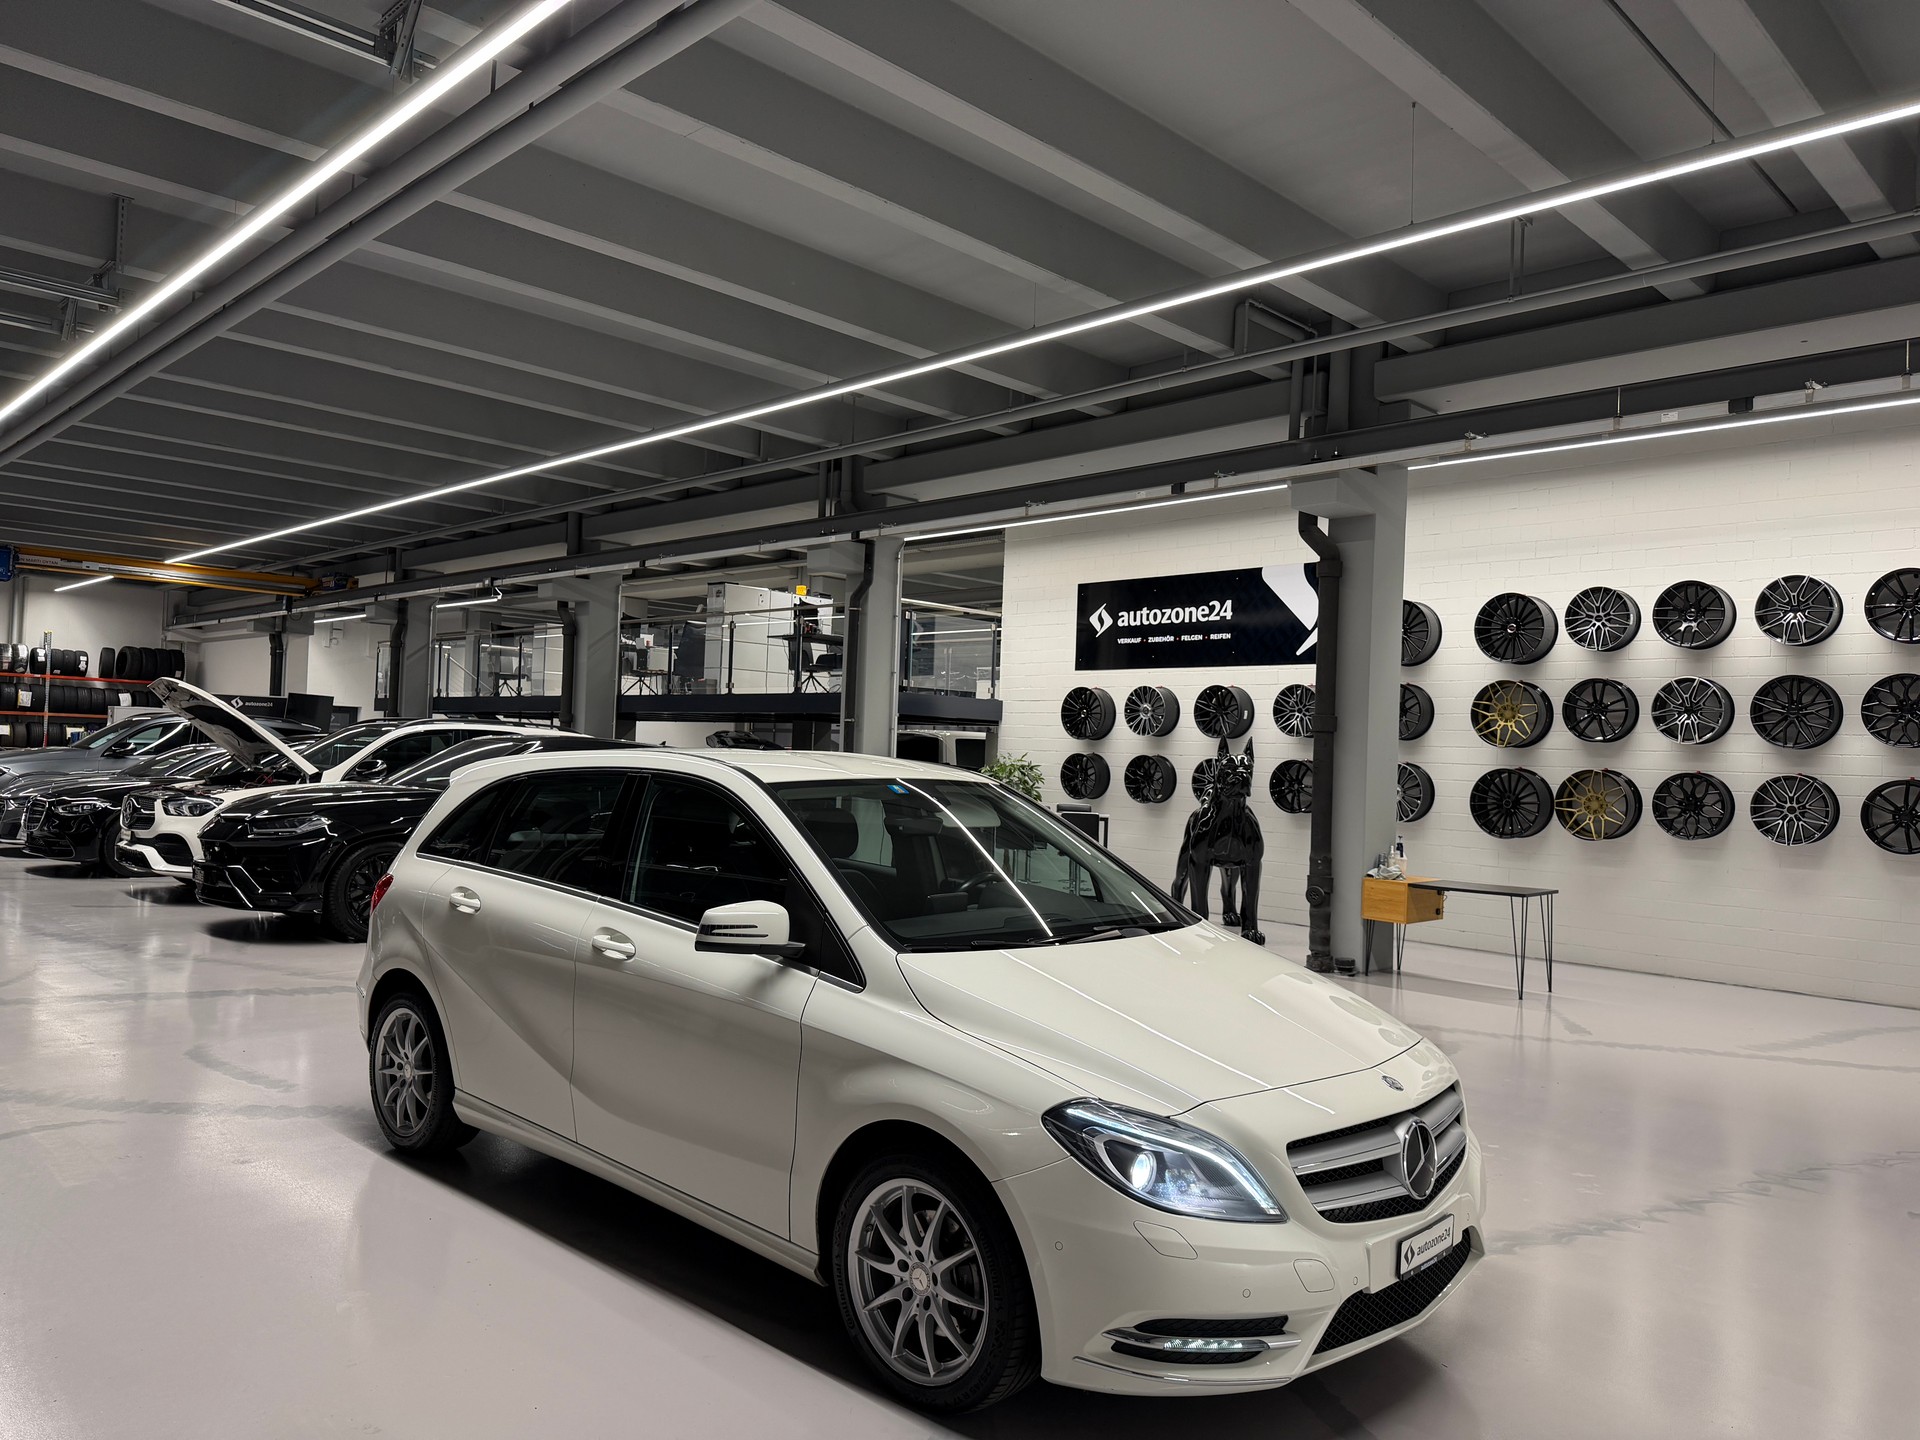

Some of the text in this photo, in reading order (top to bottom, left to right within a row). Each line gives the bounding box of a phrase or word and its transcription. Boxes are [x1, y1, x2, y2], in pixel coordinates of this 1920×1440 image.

[1118, 599, 1233, 627] autozone24
[1117, 637, 1142, 645] VERKAUF
[1148, 635, 1175, 643] ZUBEHÖR
[1416, 1227, 1451, 1256] autozone24
